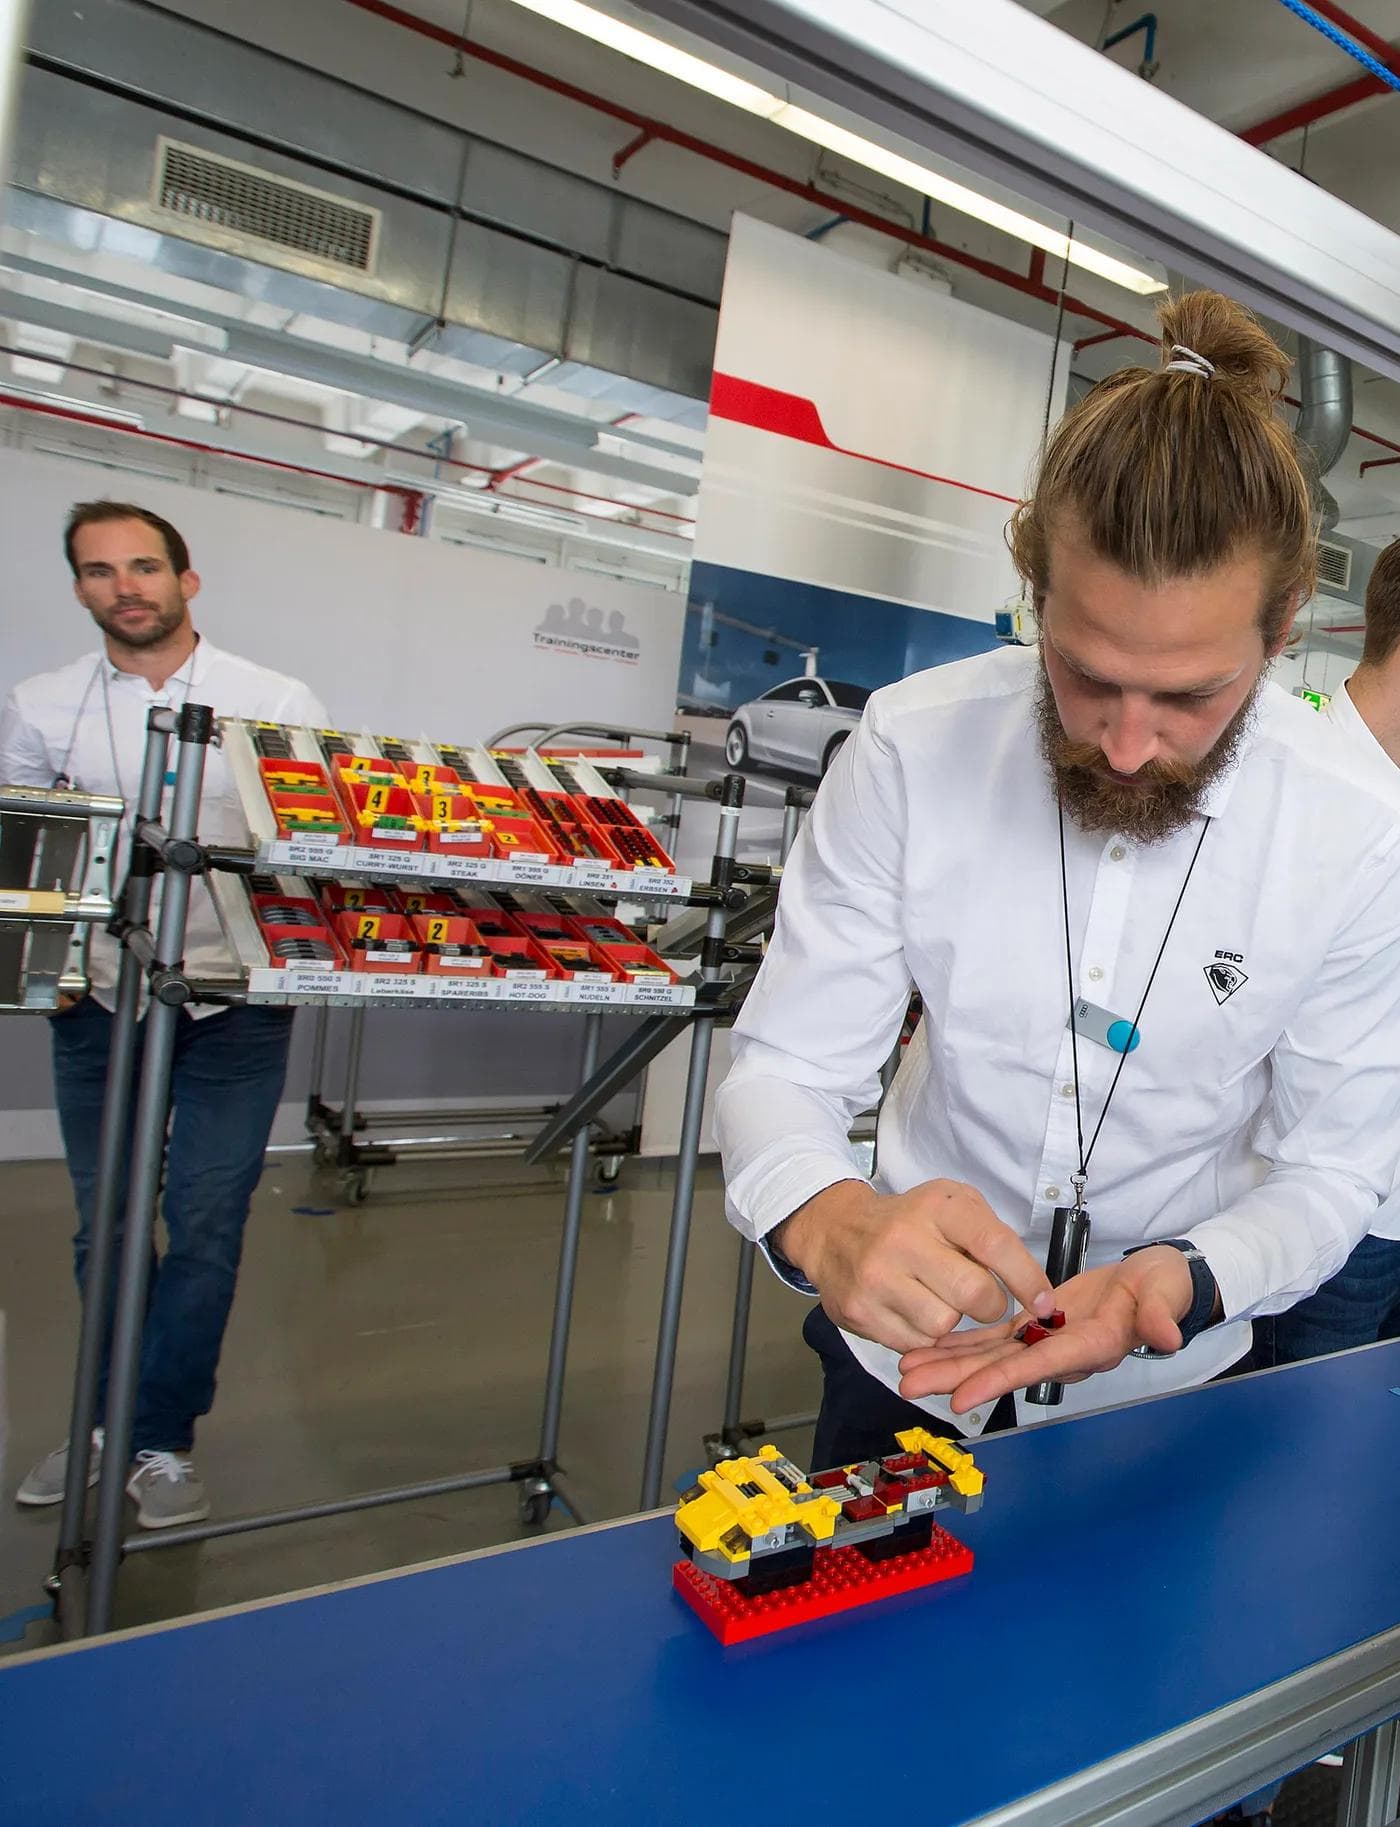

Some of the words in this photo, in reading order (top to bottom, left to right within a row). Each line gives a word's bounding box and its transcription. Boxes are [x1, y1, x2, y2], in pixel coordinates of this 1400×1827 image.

[532, 632, 640, 659] Trainingscenter
[372, 790, 382, 807] 4
[438, 800, 448, 818] 3
[356, 861, 419, 871] CURRY-WURST
[515, 872, 542, 880] DÖNER
[362, 920, 374, 938] 2
[433, 922, 443, 940] 2
[1214, 950, 1244, 963] ERC
[297, 984, 338, 992] POMMES
[634, 994, 672, 1002] SCHNITZEL
